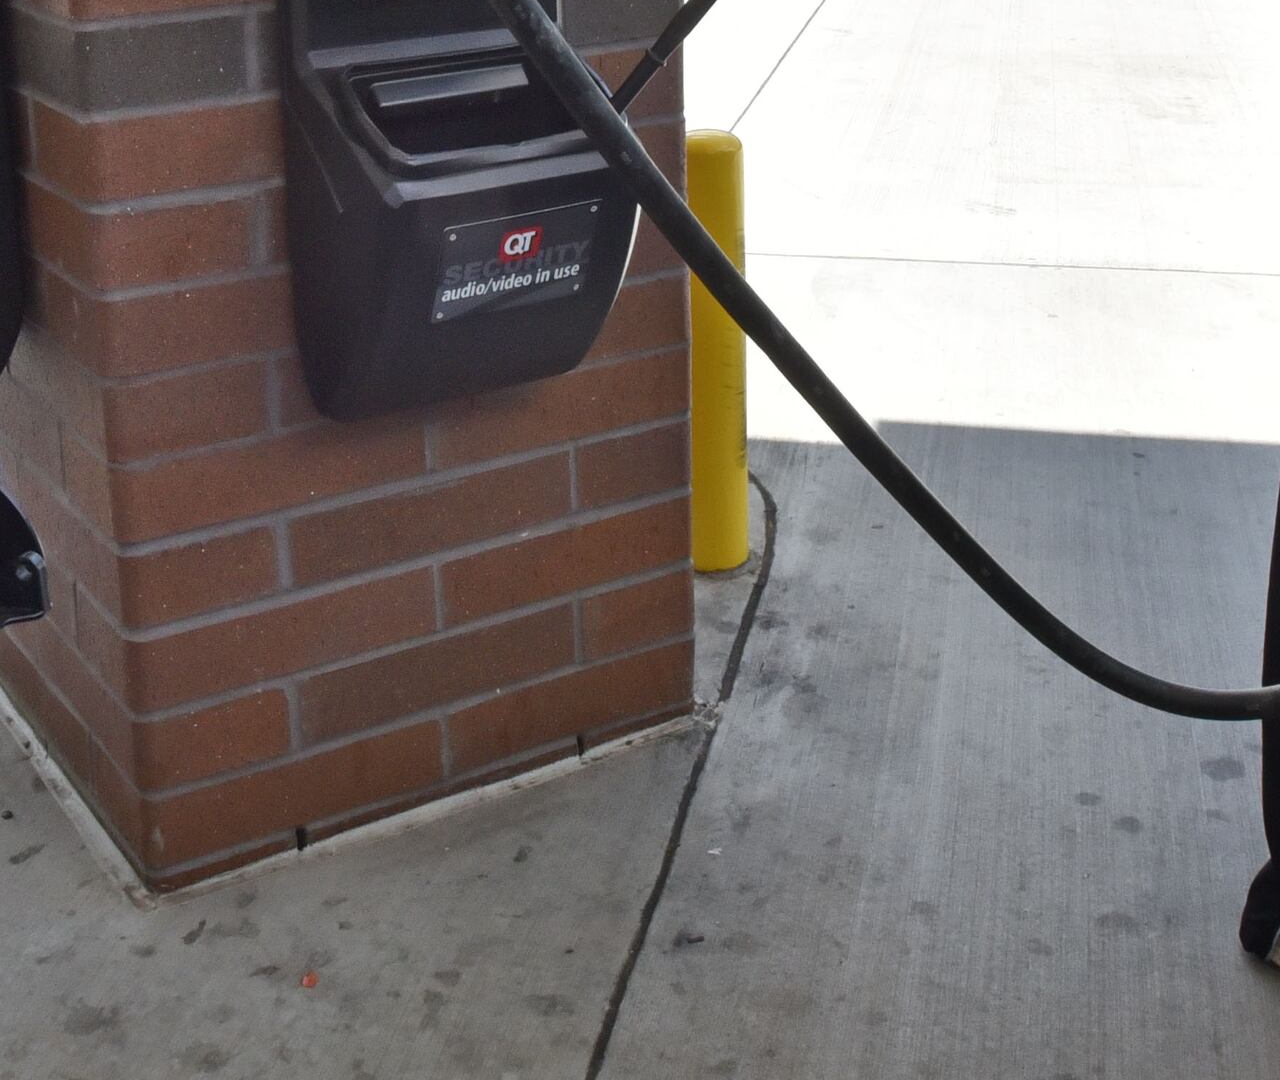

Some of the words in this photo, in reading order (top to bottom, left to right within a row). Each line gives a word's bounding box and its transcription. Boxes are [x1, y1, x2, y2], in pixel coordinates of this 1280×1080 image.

[503, 231, 536, 256] QT
[441, 273, 532, 302] audio/video
[535, 268, 549, 284] in
[553, 264, 580, 279] use
